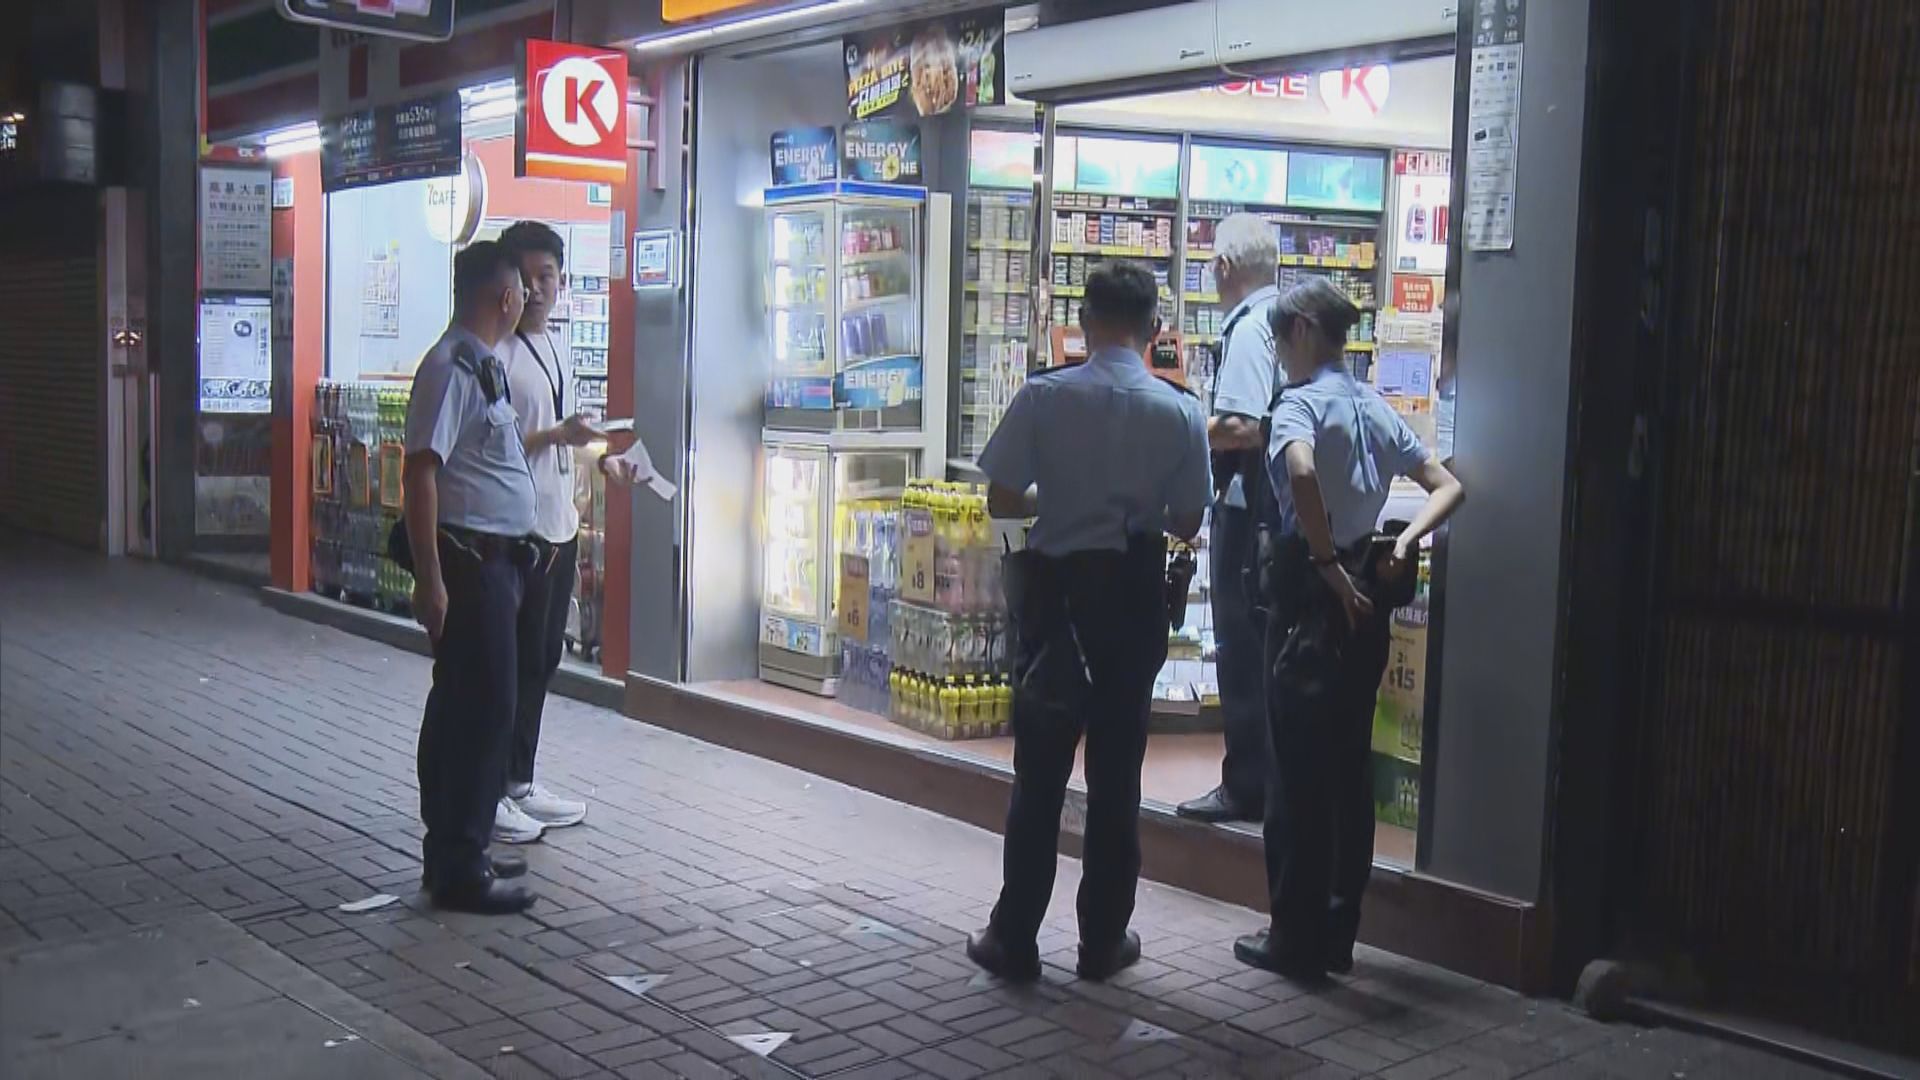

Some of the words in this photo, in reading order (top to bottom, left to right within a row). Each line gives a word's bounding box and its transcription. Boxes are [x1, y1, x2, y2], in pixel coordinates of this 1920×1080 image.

[565, 76, 613, 142] K
[1342, 65, 1379, 116] K
[774, 143, 828, 168] ENERGY
[845, 141, 908, 160] ENERGY
